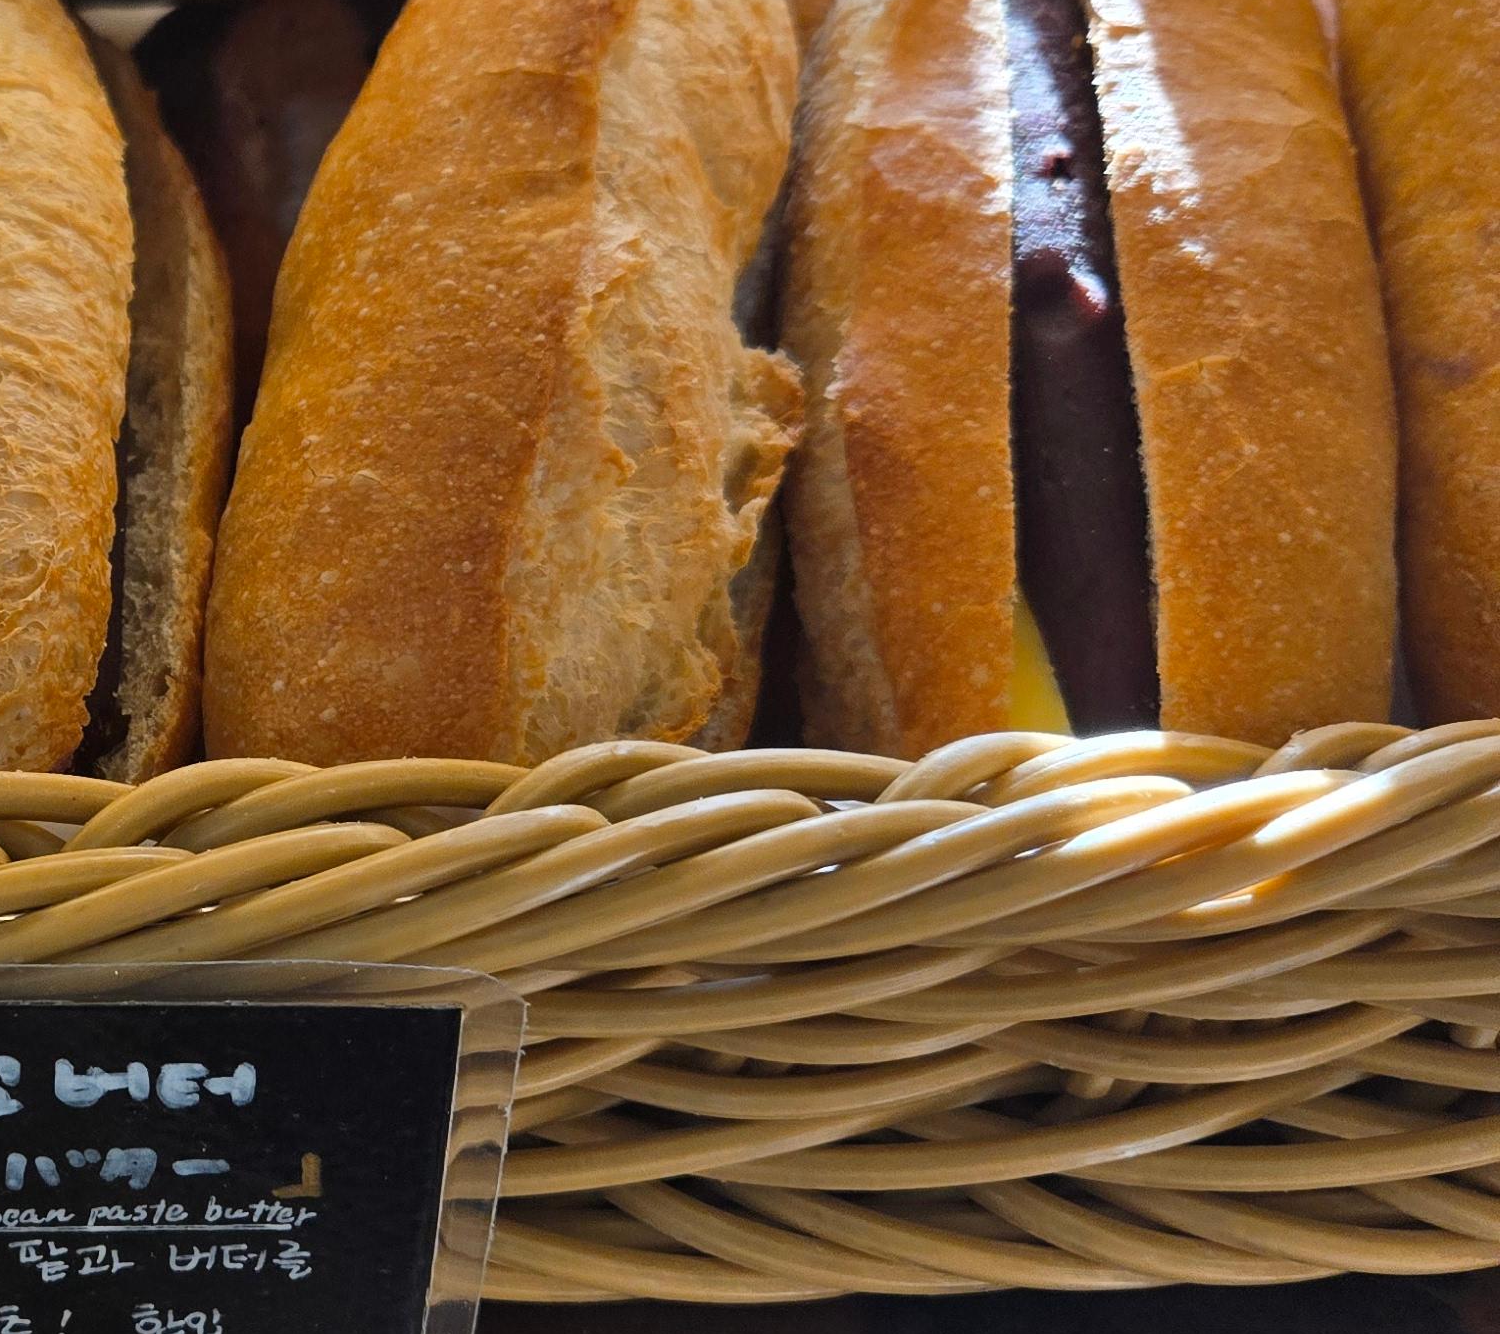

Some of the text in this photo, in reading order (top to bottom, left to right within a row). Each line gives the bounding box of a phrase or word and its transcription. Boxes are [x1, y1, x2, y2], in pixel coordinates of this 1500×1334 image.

[54, 1058, 257, 1109] 버터
[87, 1199, 188, 1229] paste
[204, 1196, 318, 1228] butter
[8, 1238, 135, 1283] 팥과
[168, 1238, 312, 1280] 버터를
